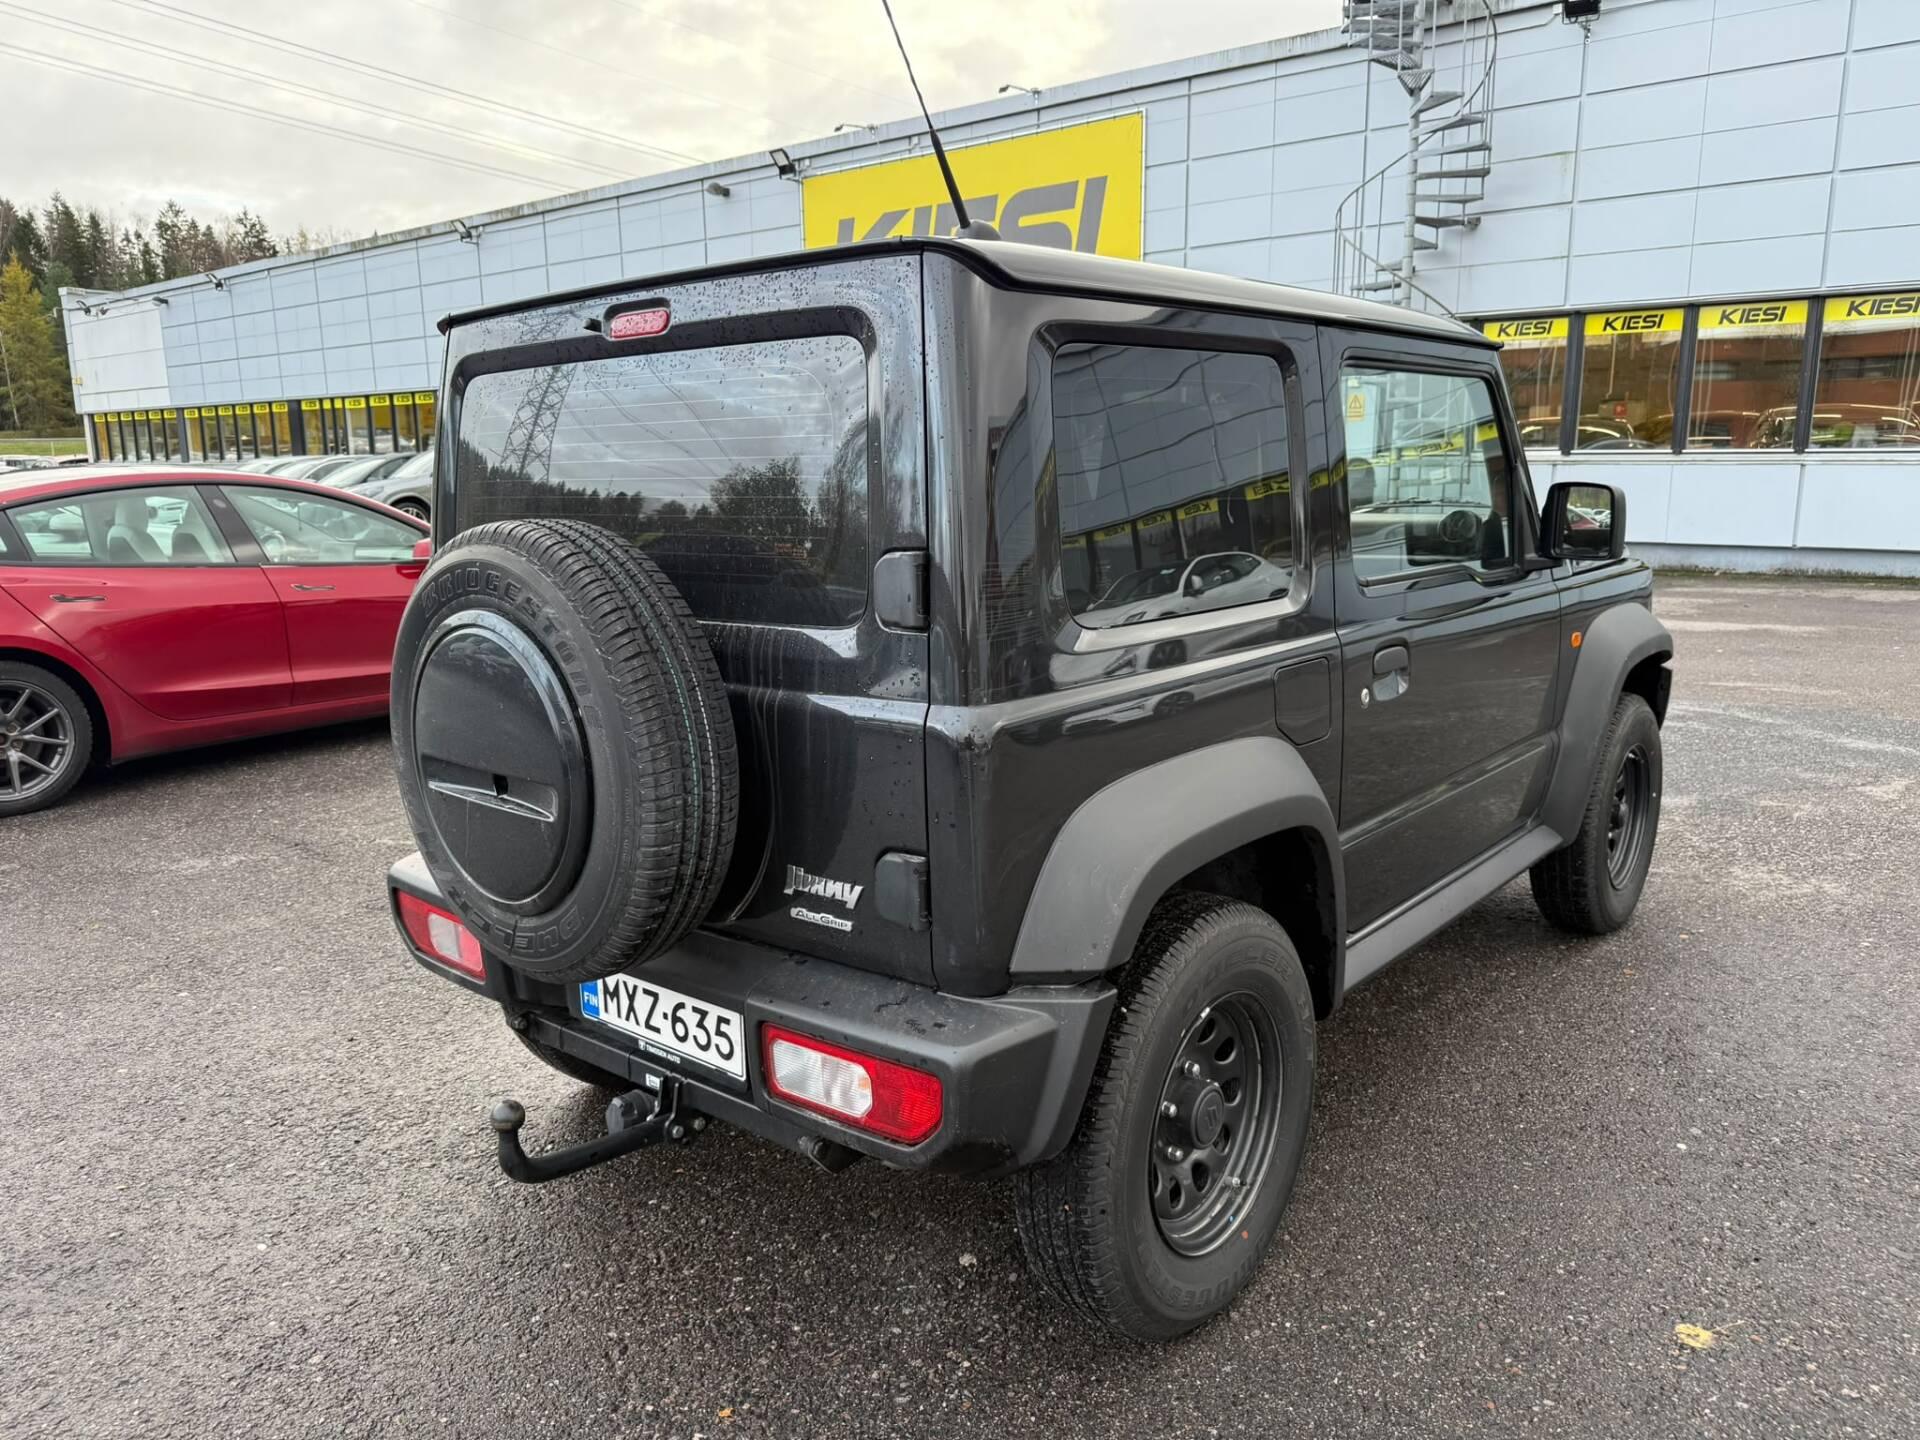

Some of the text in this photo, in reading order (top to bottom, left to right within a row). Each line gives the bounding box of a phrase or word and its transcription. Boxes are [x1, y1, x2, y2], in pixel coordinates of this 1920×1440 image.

[1718, 305, 1787, 325] KIESI
[1847, 296, 1920, 317] KIESI
[1497, 319, 1553, 338] KIESI
[1602, 313, 1664, 332] KIESI
[783, 864, 864, 910] Jimny
[584, 990, 599, 1008] FIN
[602, 977, 735, 1061] MXZ-635
